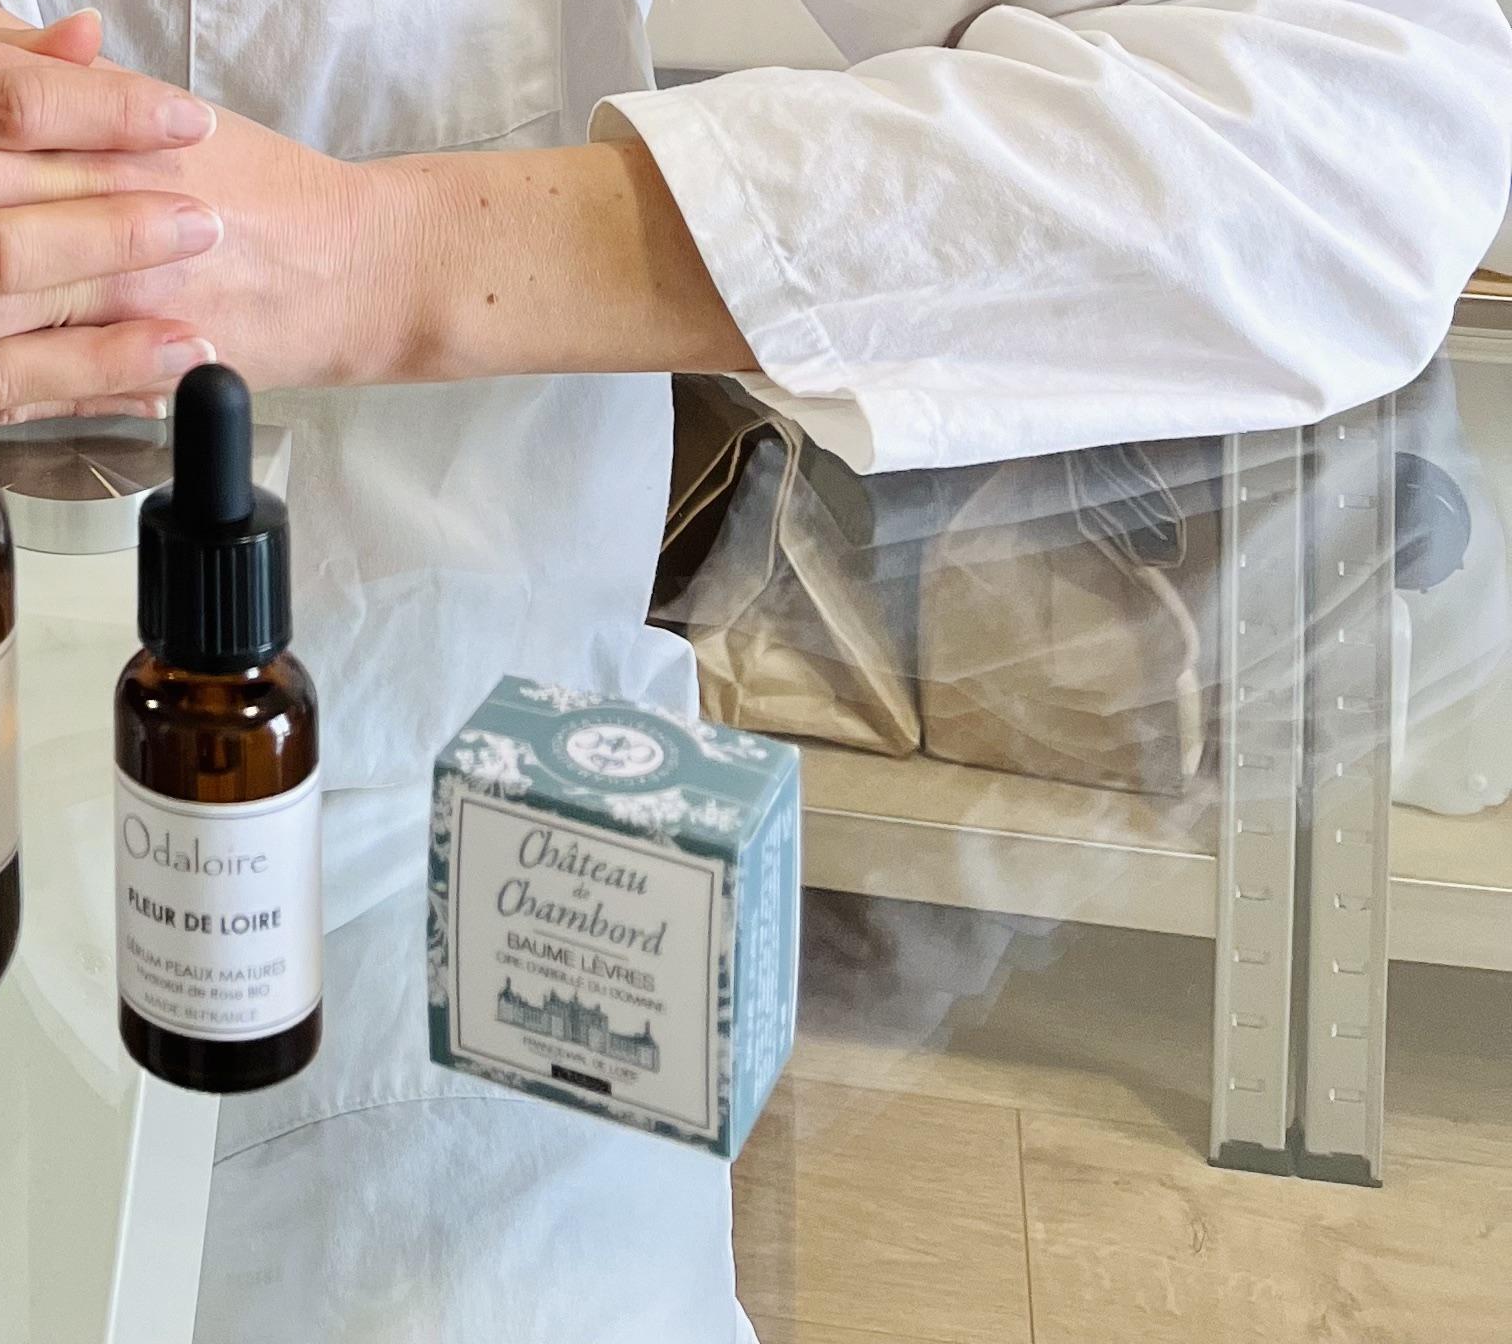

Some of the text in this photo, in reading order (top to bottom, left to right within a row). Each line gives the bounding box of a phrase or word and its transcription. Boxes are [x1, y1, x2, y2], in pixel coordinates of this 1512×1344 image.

[123, 813, 268, 876] Odaloire
[519, 828, 647, 895] Château
[128, 887, 281, 935] FLEUR DE LOIRE
[572, 881, 590, 899] de
[497, 878, 668, 955] Chambord
[165, 960, 213, 982] PEAUX
[218, 959, 287, 983] MATURES
[507, 930, 656, 993] BAUME LÈVRES
[144, 992, 177, 1013] MADE
[187, 985, 206, 998] de
[210, 988, 244, 1000] Rose
